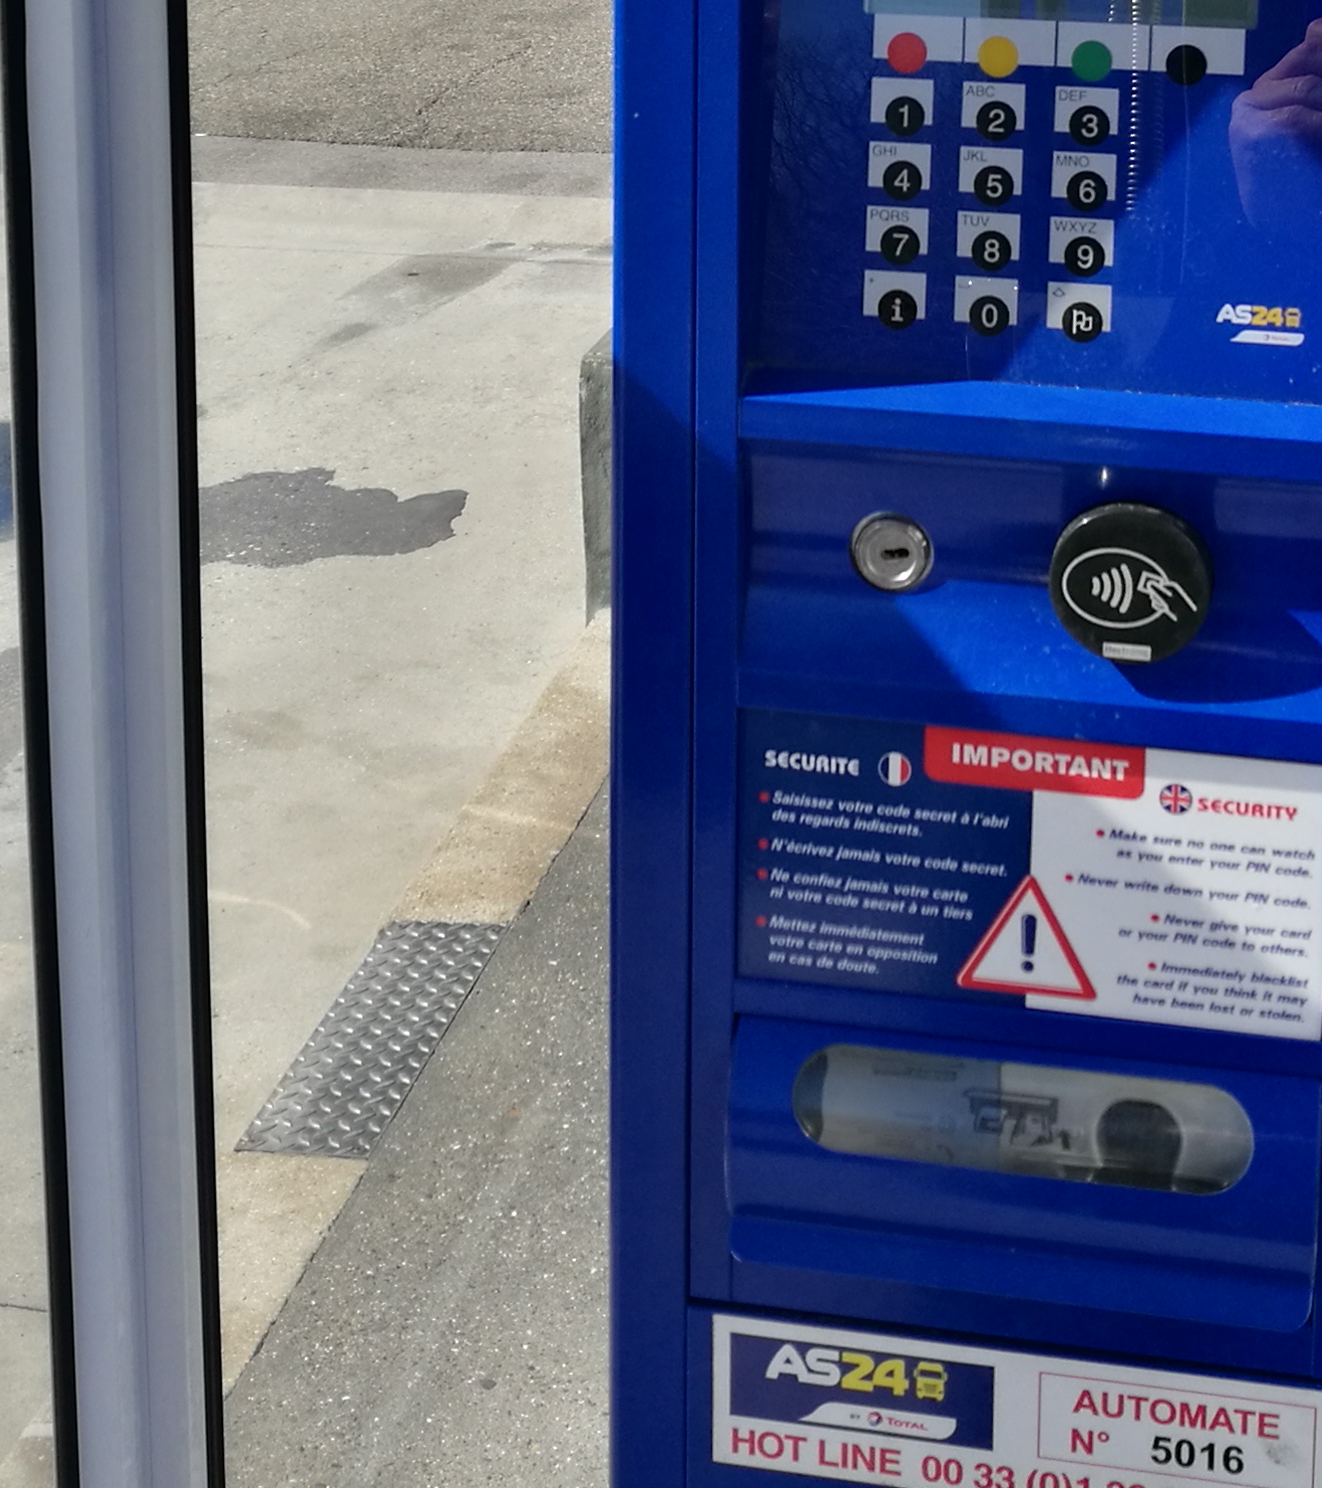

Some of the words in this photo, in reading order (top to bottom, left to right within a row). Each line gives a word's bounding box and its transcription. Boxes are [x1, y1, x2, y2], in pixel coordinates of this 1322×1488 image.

[966, 85, 995, 97] ABC
[1058, 90, 1087, 102] DEF
[898, 104, 909, 128] 1
[988, 109, 1005, 133] 2
[1081, 114, 1099, 138] 3
[872, 145, 897, 157] GHI
[963, 150, 987, 162] JKL
[1055, 155, 1089, 167] MNO
[893, 169, 910, 193] 4
[986, 174, 1003, 198] 5
[1079, 179, 1096, 203] 6
[870, 209, 909, 223] PQRS
[962, 214, 990, 227] TUV
[1054, 220, 1097, 234] WXYZ
[892, 233, 909, 256] 7
[983, 238, 1000, 263] 8
[1077, 244, 1094, 269] 9
[981, 303, 998, 328] 0
[1216, 303, 1283, 326] AS24
[764, 749, 860, 777] SECURITE
[951, 742, 1130, 782] IMPORTANT
[772, 790, 833, 809] Saisissez
[838, 800, 873, 814] votre
[876, 804, 910, 817] code
[913, 808, 957, 823] secret
[960, 812, 969, 824] à
[972, 812, 1009, 828] l'abri
[1197, 796, 1298, 821] SECURITY
[771, 808, 795, 822] des
[799, 813, 850, 828] regards
[853, 817, 921, 836] indiscrets.
[1109, 828, 1147, 842] Make
[1152, 836, 1182, 846] sure
[1186, 839, 1204, 848] no
[1209, 842, 1235, 851] one
[1240, 846, 1265, 854] can
[1271, 849, 1315, 859] watch
[770, 838, 834, 857] N'écrivez
[835, 845, 880, 862] jamais
[885, 853, 920, 867] votre
[923, 856, 958, 871] code
[961, 861, 1006, 876] secret.
[1116, 849, 1132, 858] as
[1137, 851, 1163, 862] you
[1167, 855, 1204, 865] enter
[1209, 859, 1240, 869] your
[1245, 861, 1271, 873] PIN
[1274, 866, 1312, 878] code.
[770, 867, 789, 882] Ne
[792, 872, 842, 888] confiez
[843, 876, 889, 893] jamais
[893, 884, 929, 898] votre
[932, 888, 968, 902] carte
[1077, 873, 1118, 887] Never
[1124, 881, 1159, 891] write
[1163, 883, 1203, 897] down
[1208, 890, 1239, 900] your
[1243, 891, 1269, 904] PIN
[1273, 897, 1310, 908] code.
[769, 886, 784, 898] ni
[787, 889, 822, 903] votre
[825, 893, 859, 907] code
[862, 897, 905, 912] secret
[907, 900, 917, 914] à
[920, 904, 939, 916] un
[942, 905, 972, 920] tiers
[769, 915, 816, 933] Mettez
[819, 921, 924, 945] immédiatement
[1163, 913, 1204, 927] Never
[1209, 920, 1239, 932] give
[1244, 925, 1275, 935] your
[1280, 929, 1312, 939] card
[769, 935, 804, 948] votre
[807, 939, 842, 953] carte
[845, 943, 863, 955] en
[866, 946, 937, 964] opposition
[1118, 929, 1132, 937] or
[1137, 930, 1168, 941] your
[1172, 932, 1198, 944] PIN
[1202, 937, 1236, 949] code
[1241, 940, 1255, 952] to
[1260, 943, 1307, 957] others.
[768, 951, 785, 962] en
[788, 953, 812, 966] cas
[816, 956, 833, 968] de
[836, 958, 878, 973] doute.
[1160, 961, 1245, 982] Immediately
[1250, 972, 1308, 988] blacklist
[1116, 974, 1138, 986] the
[1143, 979, 1175, 990] card
[1177, 980, 1188, 991] if
[1193, 985, 1218, 995] you
[1223, 986, 1257, 999] think
[1262, 990, 1272, 1001] it
[1277, 994, 1307, 1007] may
[1132, 993, 1166, 1006] have
[1170, 997, 1204, 1010] been
[1209, 1001, 1235, 1014] lost
[1239, 1007, 1254, 1015] or
[1259, 1009, 1304, 1022] stolen.
[765, 1343, 908, 1398] AS24
[887, 1417, 928, 1431] TOTAL
[1072, 1389, 1280, 1440] AUTOMATE
[731, 1428, 807, 1462] HOT
[818, 1440, 902, 1477] LINE
[921, 1455, 964, 1486] 00
[973, 1463, 1015, 1488] 33
[1070, 1428, 1109, 1455] N°
[1150, 1435, 1245, 1475] 5016
